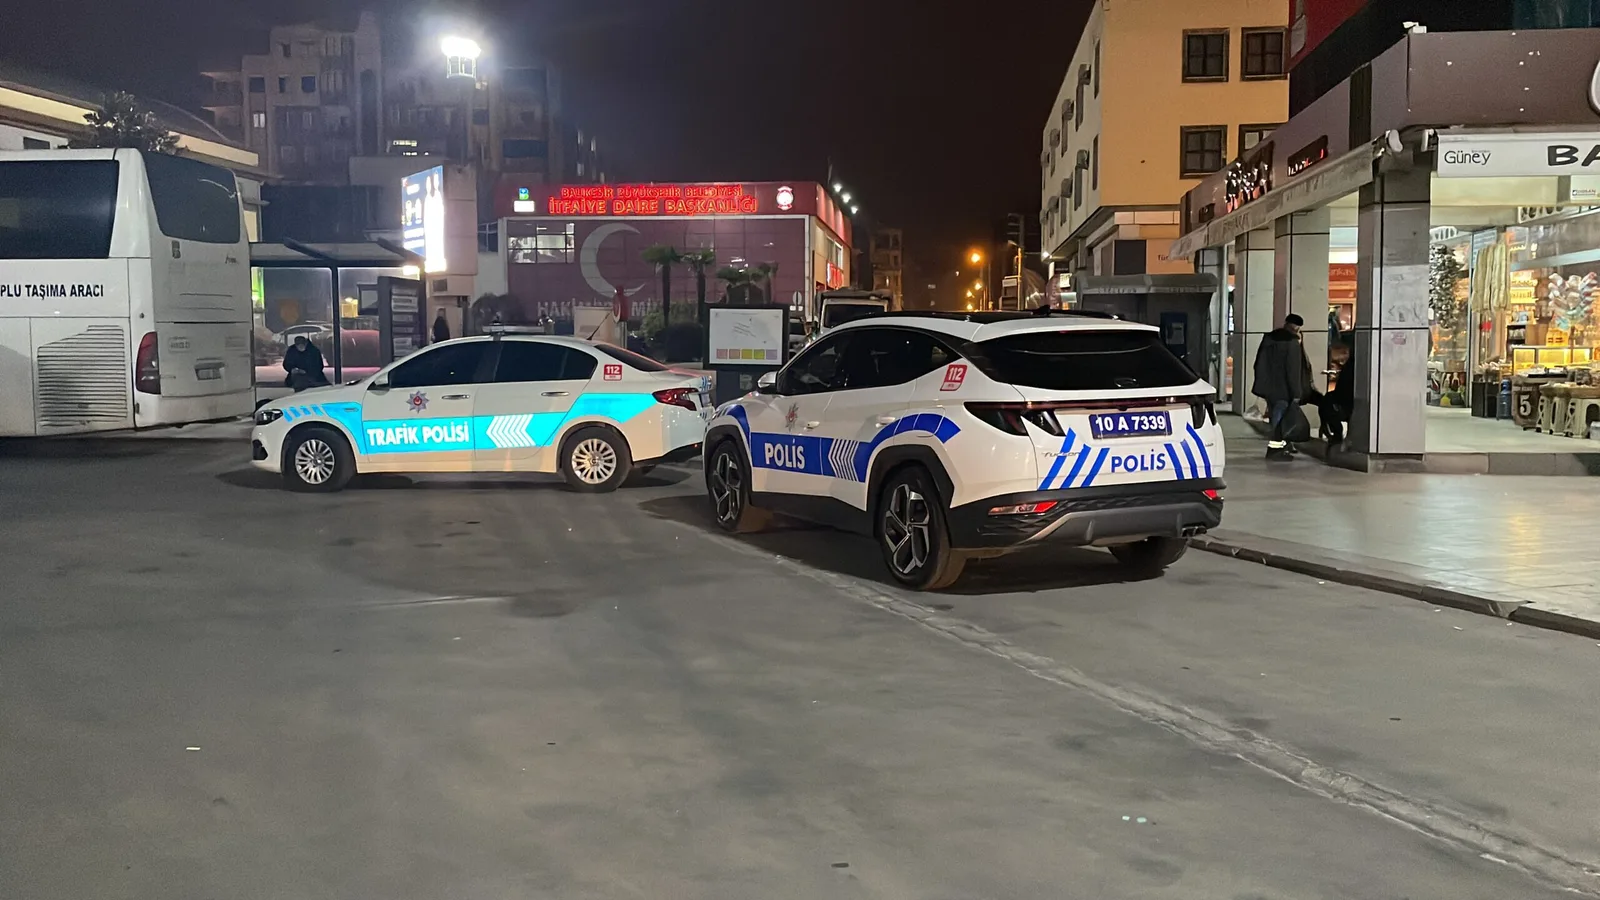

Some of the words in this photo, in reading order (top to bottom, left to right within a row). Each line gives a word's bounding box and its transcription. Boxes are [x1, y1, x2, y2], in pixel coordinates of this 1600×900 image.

[1444, 150, 1491, 165] Güney
[549, 197, 606, 213] İTFAİYE
[613, 198, 658, 213] DAİRE
[665, 195, 757, 216] BAŞKANLIĞI
[0, 284, 21, 297] PLU
[25, 284, 66, 300] TAŞIMA
[70, 284, 104, 297] ARACI
[606, 366, 620, 374] 112
[948, 367, 964, 380] 112
[1520, 395, 1531, 416] 5
[1096, 417, 1113, 431] 10
[1118, 416, 1129, 431] A
[1132, 415, 1166, 430] 7339
[367, 423, 420, 446] TRAFİK
[422, 421, 469, 443] POLİSİ
[764, 438, 805, 469] POLİS
[1111, 449, 1166, 473] POLİS
